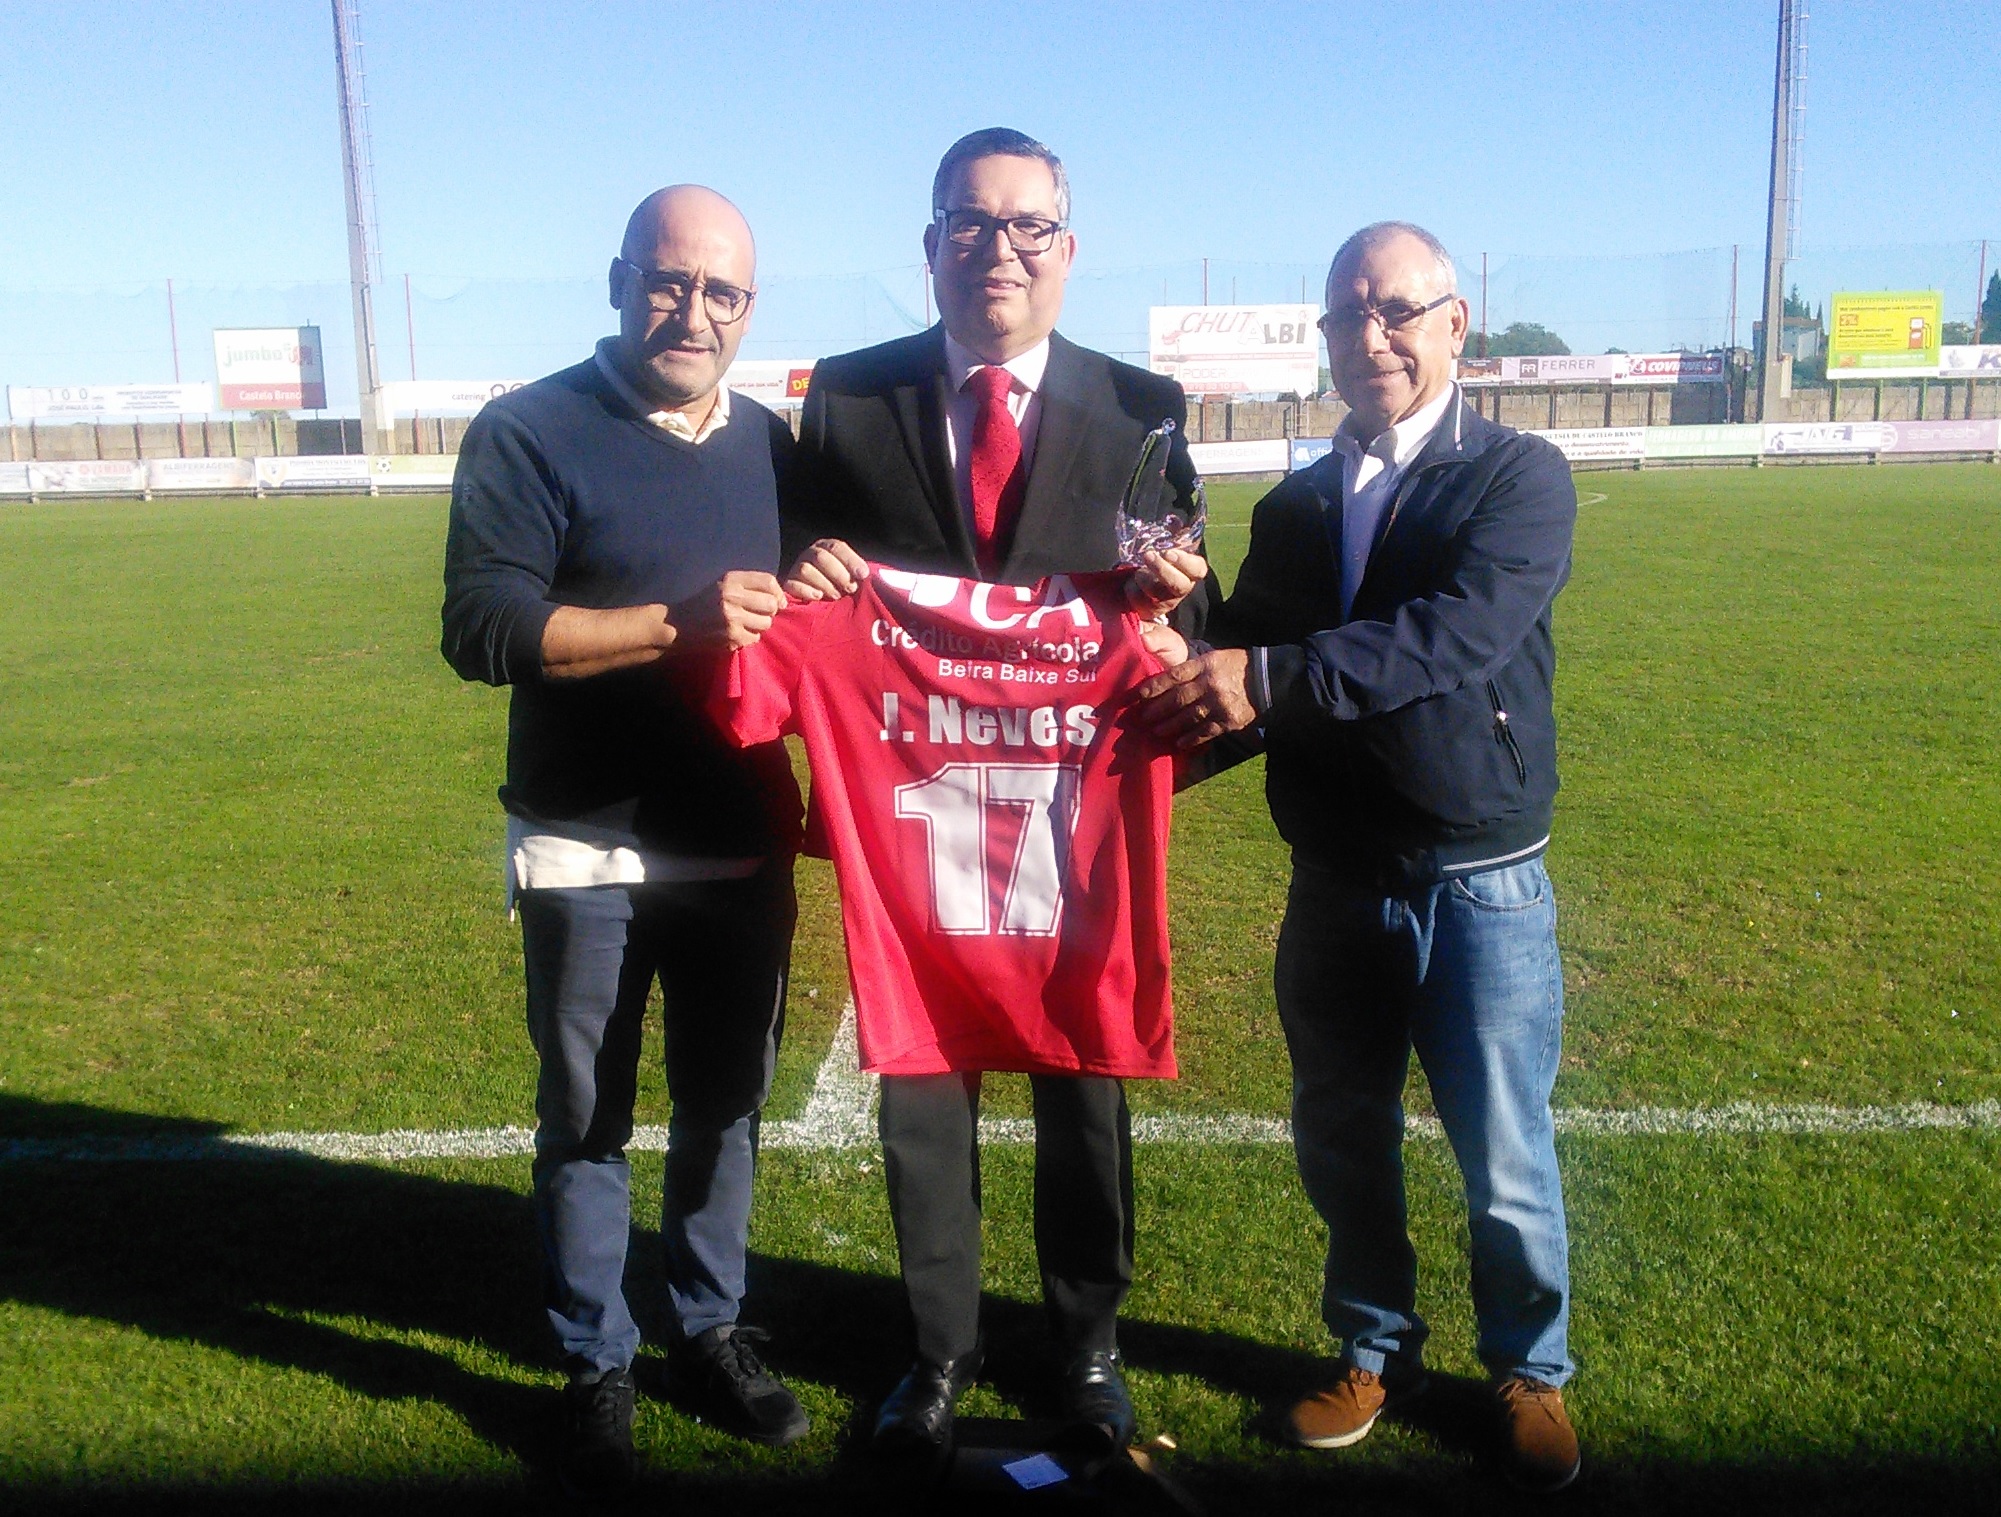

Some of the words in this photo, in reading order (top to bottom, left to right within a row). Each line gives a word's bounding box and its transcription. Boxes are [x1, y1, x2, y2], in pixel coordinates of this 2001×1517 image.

[223, 346, 283, 367] jumbo
[1541, 360, 1596, 370] FERRER
[240, 391, 273, 401] Castelo
[274, 391, 302, 401] Branc
[452, 393, 486, 402] catering
[970, 574, 1091, 630] CA
[871, 618, 973, 654] Crédito
[983, 635, 1100, 664] Agrícola
[938, 658, 993, 680] Beira
[1000, 663, 1059, 685] Baixa
[1065, 667, 1097, 684] Sul
[879, 692, 915, 742] J.
[928, 693, 1098, 748] Neves
[894, 760, 1083, 938] 17
